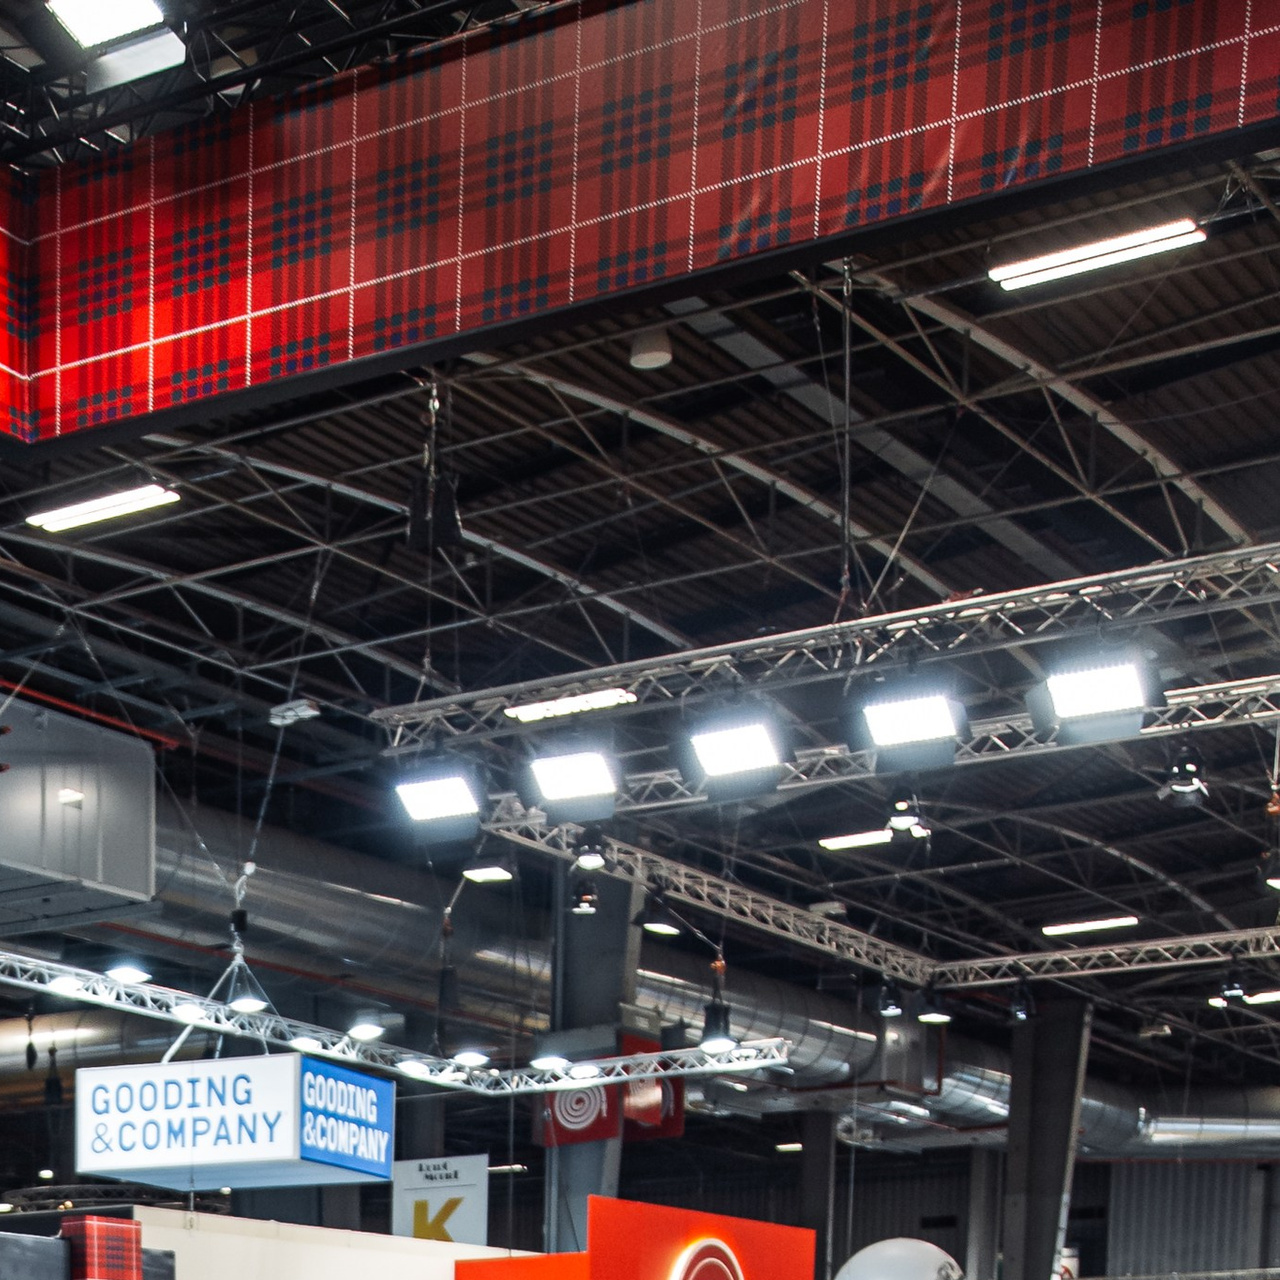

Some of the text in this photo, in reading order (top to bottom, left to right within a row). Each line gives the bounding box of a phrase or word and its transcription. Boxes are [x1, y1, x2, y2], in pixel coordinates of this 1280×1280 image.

[91, 1073, 253, 1116] GOODING
[303, 1071, 378, 1122] GOODING
[91, 1111, 283, 1154] &COMPANY
[303, 1114, 390, 1164] &COMPANY
[413, 1196, 465, 1242] K
